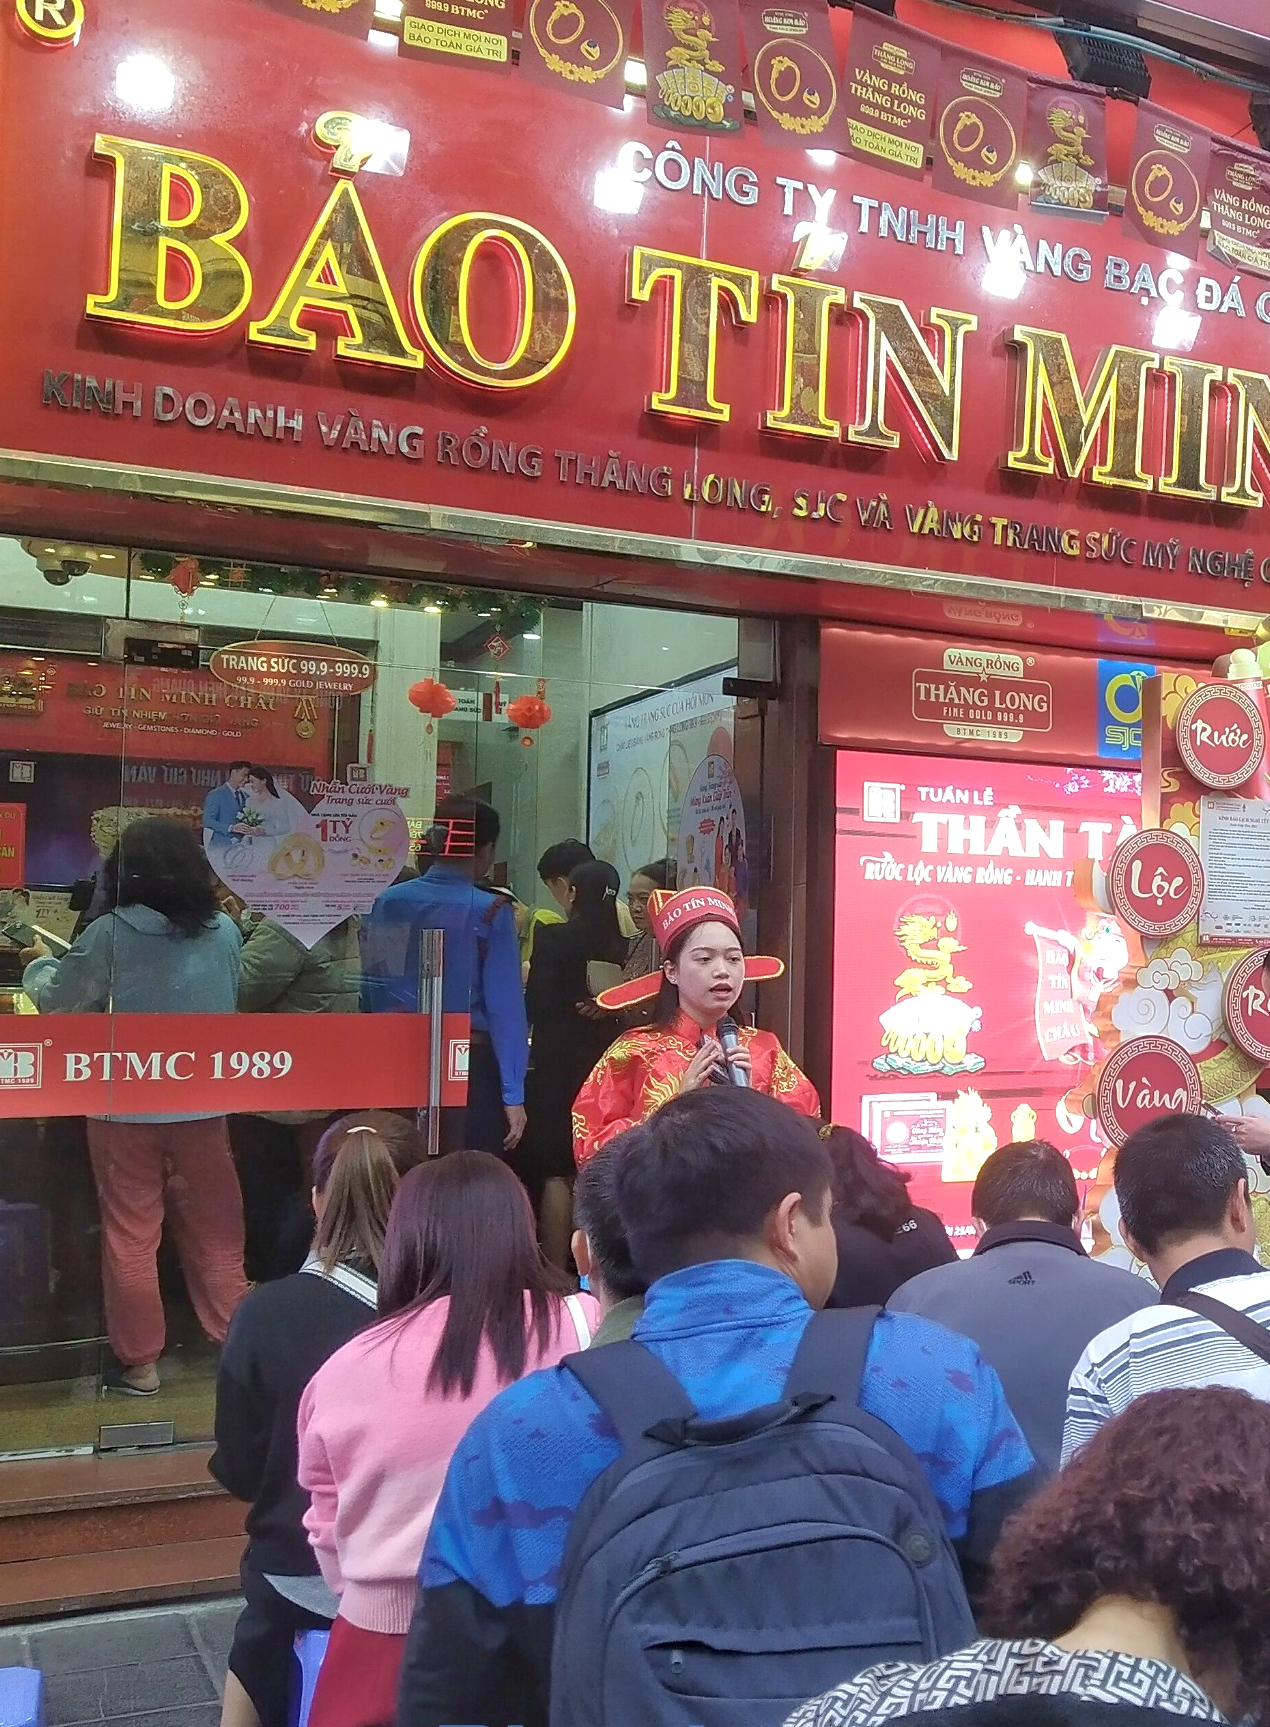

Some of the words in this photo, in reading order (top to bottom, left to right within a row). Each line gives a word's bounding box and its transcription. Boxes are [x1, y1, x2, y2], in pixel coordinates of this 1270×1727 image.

[410, 21, 434, 32] GIAO
[437, 26, 461, 37] DỊCH
[463, 31, 482, 42] MỌI
[484, 36, 503, 46] NƠI
[434, 38, 462, 51] TOÀN
[486, 48, 502, 59] TRỊ
[896, 55, 914, 70] LONG
[854, 68, 888, 91] VÀNG
[890, 82, 926, 105] RỒNG
[849, 82, 891, 109] THĂNG
[893, 100, 926, 120] LONG
[864, 139, 887, 154] TOÀN
[888, 149, 904, 161] GIÁ
[905, 153, 919, 166] TRỊ
[866, 129, 887, 143] DỊCH
[888, 137, 904, 150] MỌI
[904, 143, 920, 154] NƠI
[1212, 201, 1243, 222] THĂNG
[1213, 188, 1240, 207] VÀNG
[1241, 197, 1270, 216] RỒNG
[619, 140, 760, 207] CÔNG
[775, 176, 838, 224] TY
[852, 195, 966, 256] TNHH
[981, 223, 1092, 282] VÀNG
[1104, 254, 1186, 306] BẠC
[1196, 275, 1246, 318] ĐÁ
[86, 110, 578, 390] BẢO
[628, 222, 978, 462] TÍN
[41, 368, 144, 420] KINH
[152, 385, 304, 443] DOANH
[316, 406, 426, 460] VÀNG
[436, 425, 544, 478] RỒNG
[554, 449, 673, 498] THĂNG
[683, 467, 782, 519] LONG,
[792, 487, 848, 524] SJC
[856, 492, 894, 531] VÀ
[905, 500, 983, 543] VÀNG
[989, 515, 1081, 557] TRANG
[1084, 526, 1137, 565] SỨC
[1142, 537, 1181, 570] MỸ
[1188, 546, 1255, 588] NGHỆ
[220, 654, 268, 672] TRANG
[270, 656, 298, 675] SỨC
[947, 651, 983, 670] VÀNG
[985, 654, 1020, 674] RỒNG
[236, 675, 255, 685] 99.9
[262, 677, 287, 687] 999.9
[288, 678, 314, 689] GOLD
[315, 681, 354, 692] JEWELRY
[915, 680, 989, 706] THĂNG
[994, 690, 1049, 713] LONG
[132, 708, 167, 722] NHIỆM
[942, 706, 966, 718] FINE
[969, 708, 993, 721] GOLD
[996, 710, 1024, 724] 999.9
[137, 723, 179, 734] GEMSTONES
[183, 727, 218, 736] DIAMOND
[222, 730, 242, 738] GOLD
[956, 727, 982, 738] BTMC
[986, 730, 1009, 740] 1989
[1191, 719, 1252, 749] Rước
[311, 780, 346, 795] Nhẫn
[348, 783, 376, 795] Cưới
[377, 783, 409, 798] Vàng
[326, 794, 355, 806] Trang
[357, 797, 373, 806] sức
[375, 797, 397, 806] cưới
[916, 785, 969, 805] TUẦN
[315, 819, 328, 842] 1
[329, 817, 354, 834] TỶ
[912, 804, 1065, 859] THẦN
[906, 859, 935, 886] LỘC
[936, 860, 972, 885] VÀNG
[975, 859, 1013, 886] RỒNG
[1024, 869, 1063, 888] HANH
[1130, 859, 1188, 906] Lộc
[661, 909, 682, 931] BẢO
[682, 897, 706, 912] TÍN
[62, 1050, 197, 1083] BTMC
[209, 1050, 294, 1080] 1989
[1115, 1077, 1189, 1110] Vàng
[1008, 1278, 1036, 1286] SPORT
